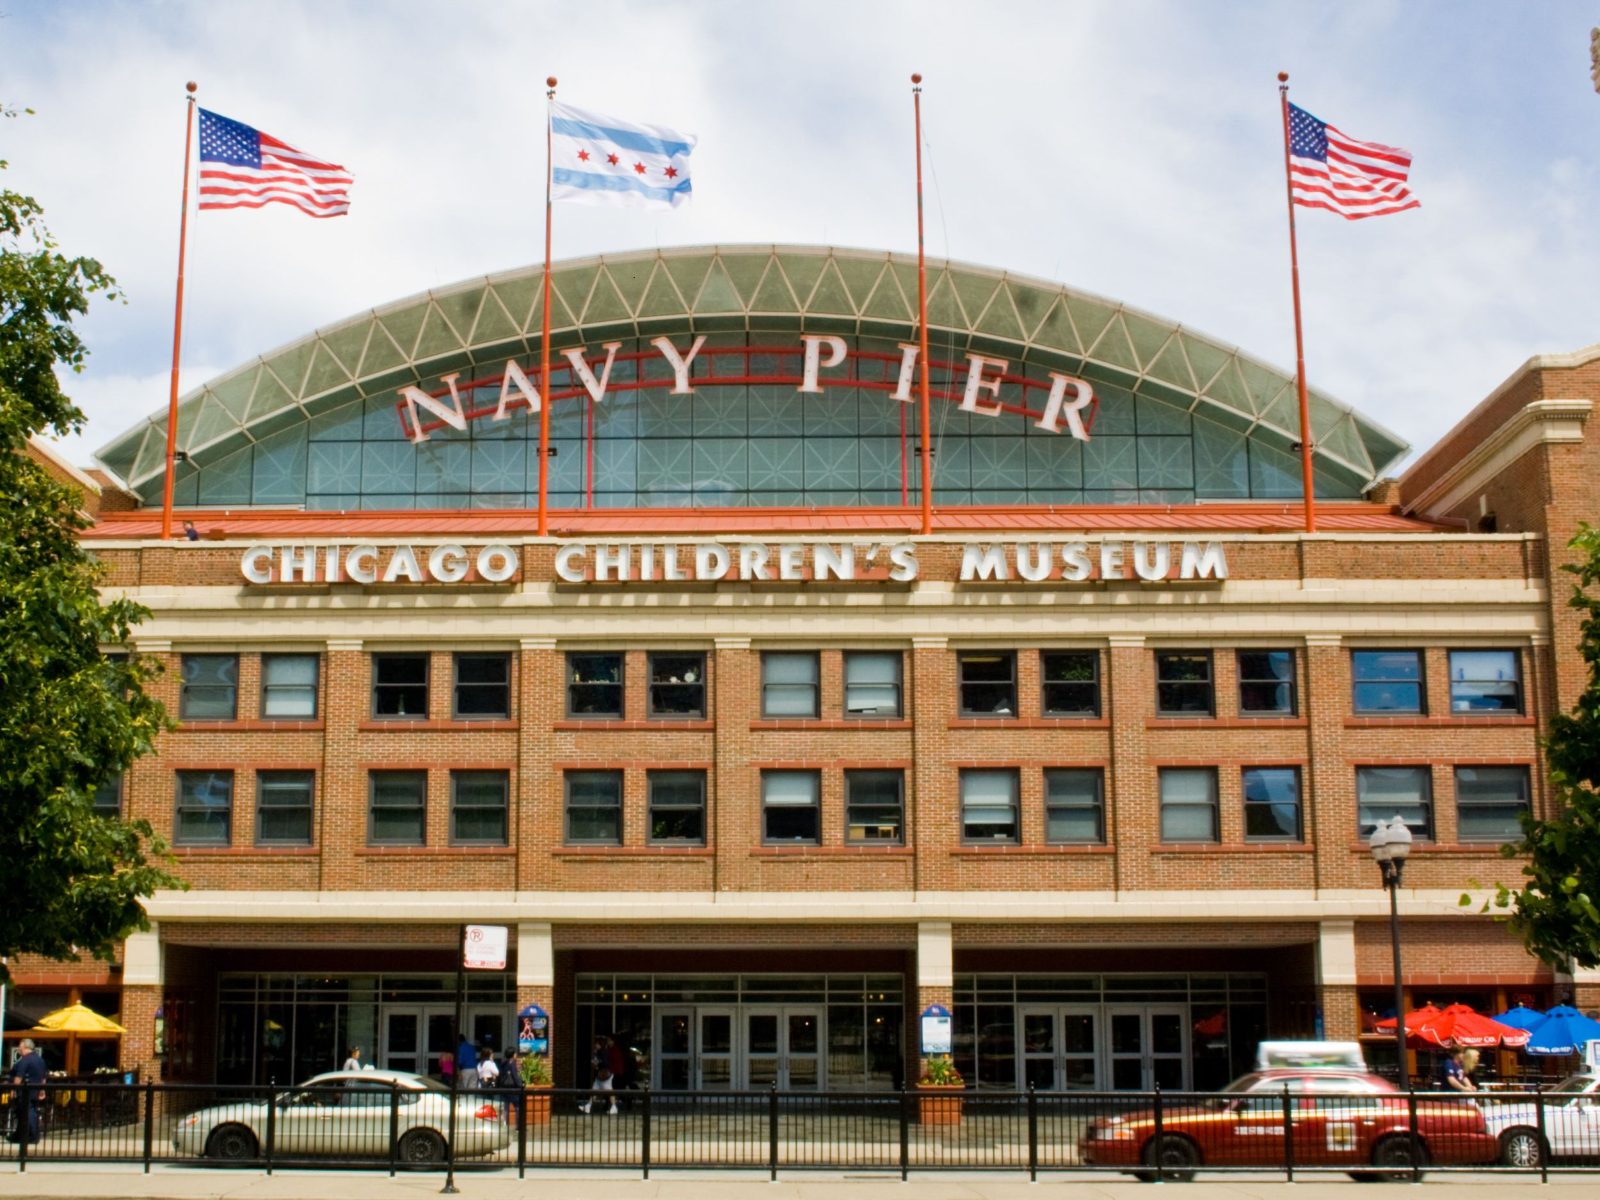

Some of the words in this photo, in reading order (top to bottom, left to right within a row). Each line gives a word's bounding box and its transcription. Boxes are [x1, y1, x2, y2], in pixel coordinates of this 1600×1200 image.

[397, 335, 707, 444] NAVY
[797, 333, 1093, 442] PIER
[240, 543, 519, 585] CHICAGO
[554, 540, 920, 584] CHILDREN'S
[959, 540, 1229, 583] MUSEUM
